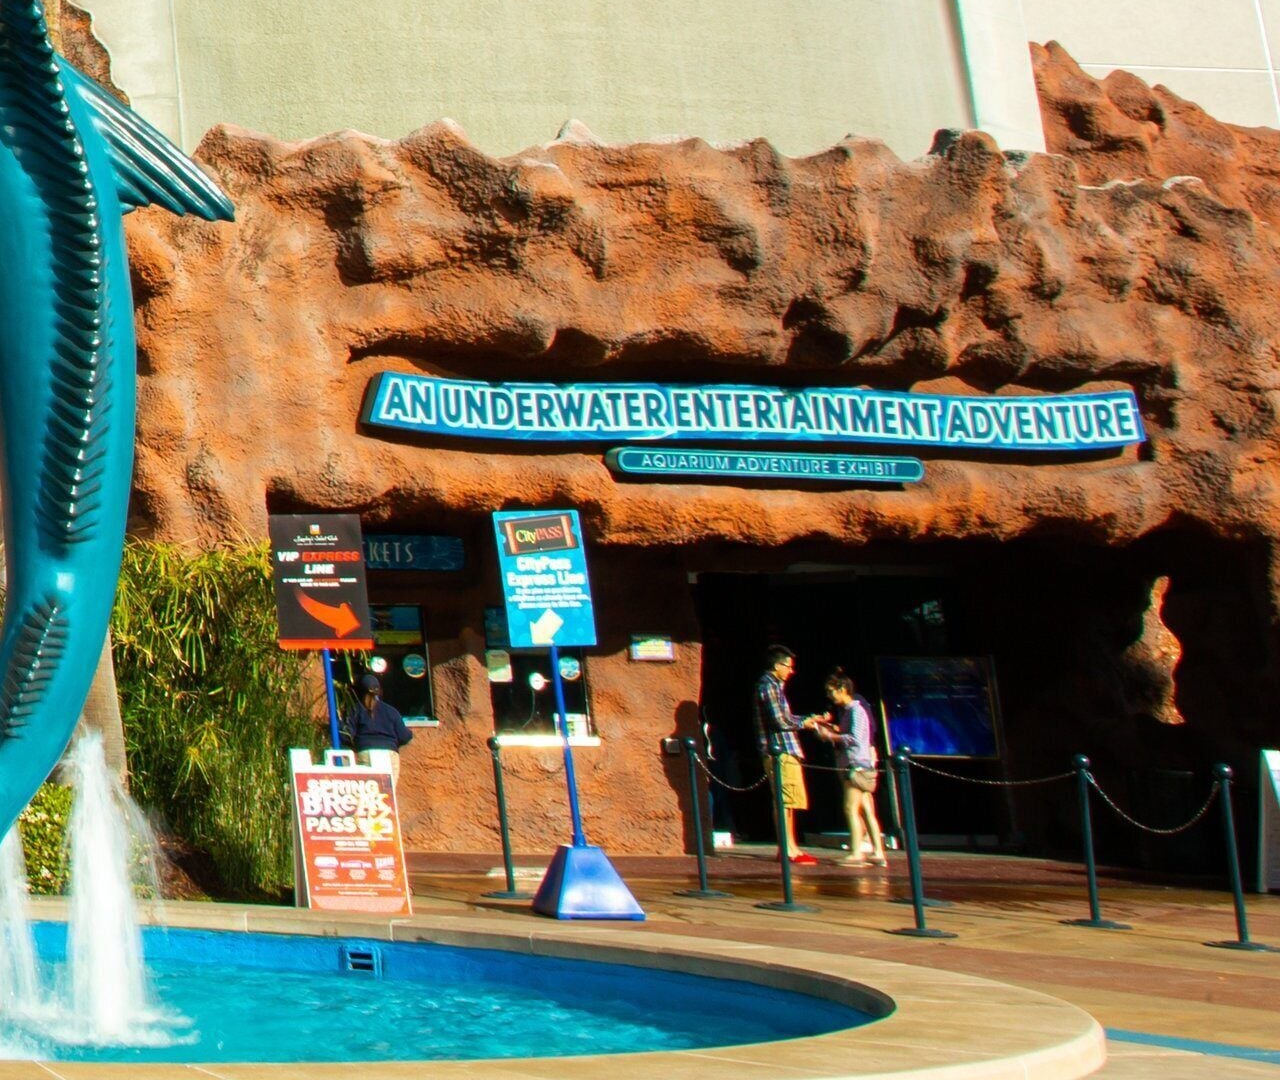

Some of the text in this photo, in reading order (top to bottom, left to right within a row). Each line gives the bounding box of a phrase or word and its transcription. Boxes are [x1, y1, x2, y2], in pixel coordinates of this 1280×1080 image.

[382, 379, 1135, 441] AN UNDERWATER ENTERTAINMENT ADVENTURE
[642, 454, 897, 476] AQUARIUM ADVENTURE EXHIBIT
[276, 551, 360, 562] VIP EXPRESS
[368, 541, 414, 562] KETS
[303, 563, 335, 574] LINE
[306, 779, 379, 797] SPRING
[306, 816, 357, 833] PASS
